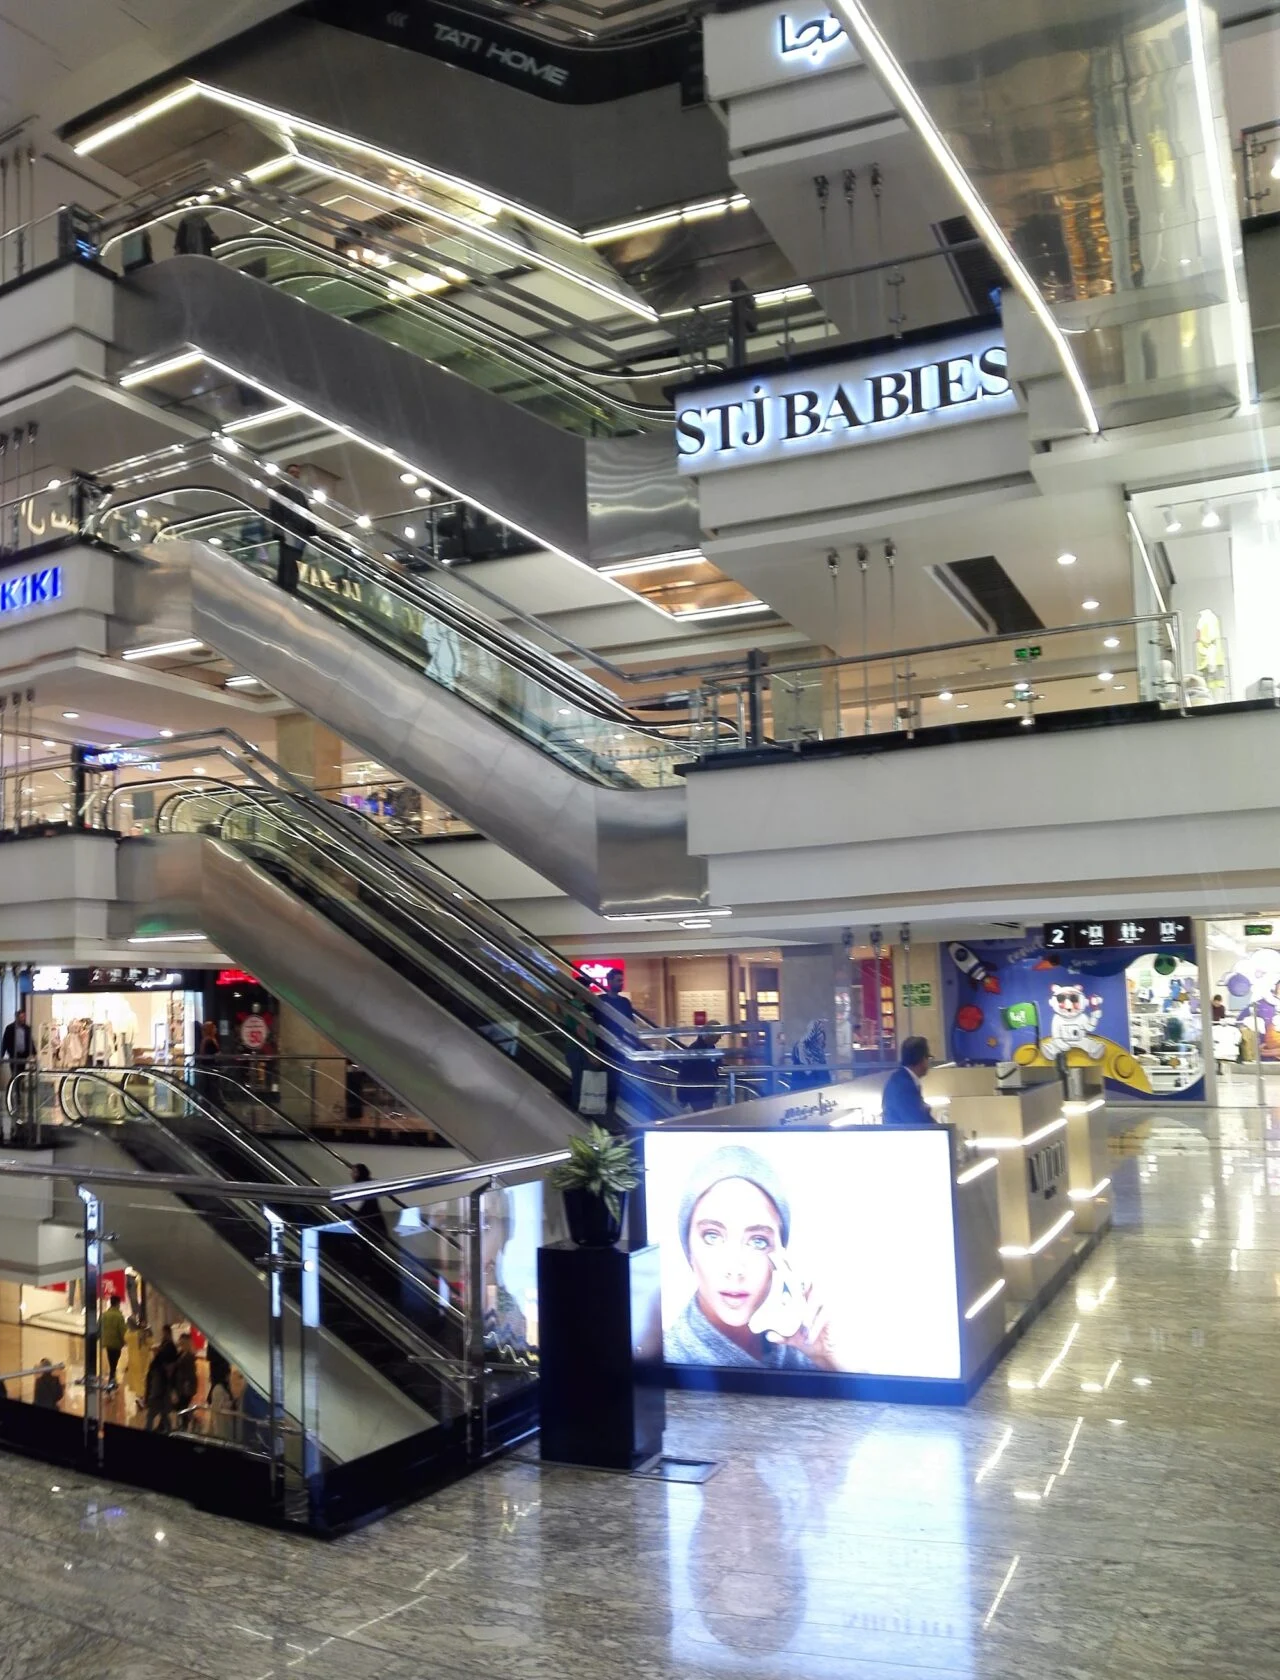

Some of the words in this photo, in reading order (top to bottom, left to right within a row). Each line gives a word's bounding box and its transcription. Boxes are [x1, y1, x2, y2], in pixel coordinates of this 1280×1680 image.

[433, 22, 483, 53] TATI
[485, 42, 570, 87] HOME
[780, 346, 1012, 442] BABIES
[1052, 929, 1065, 944] 2
